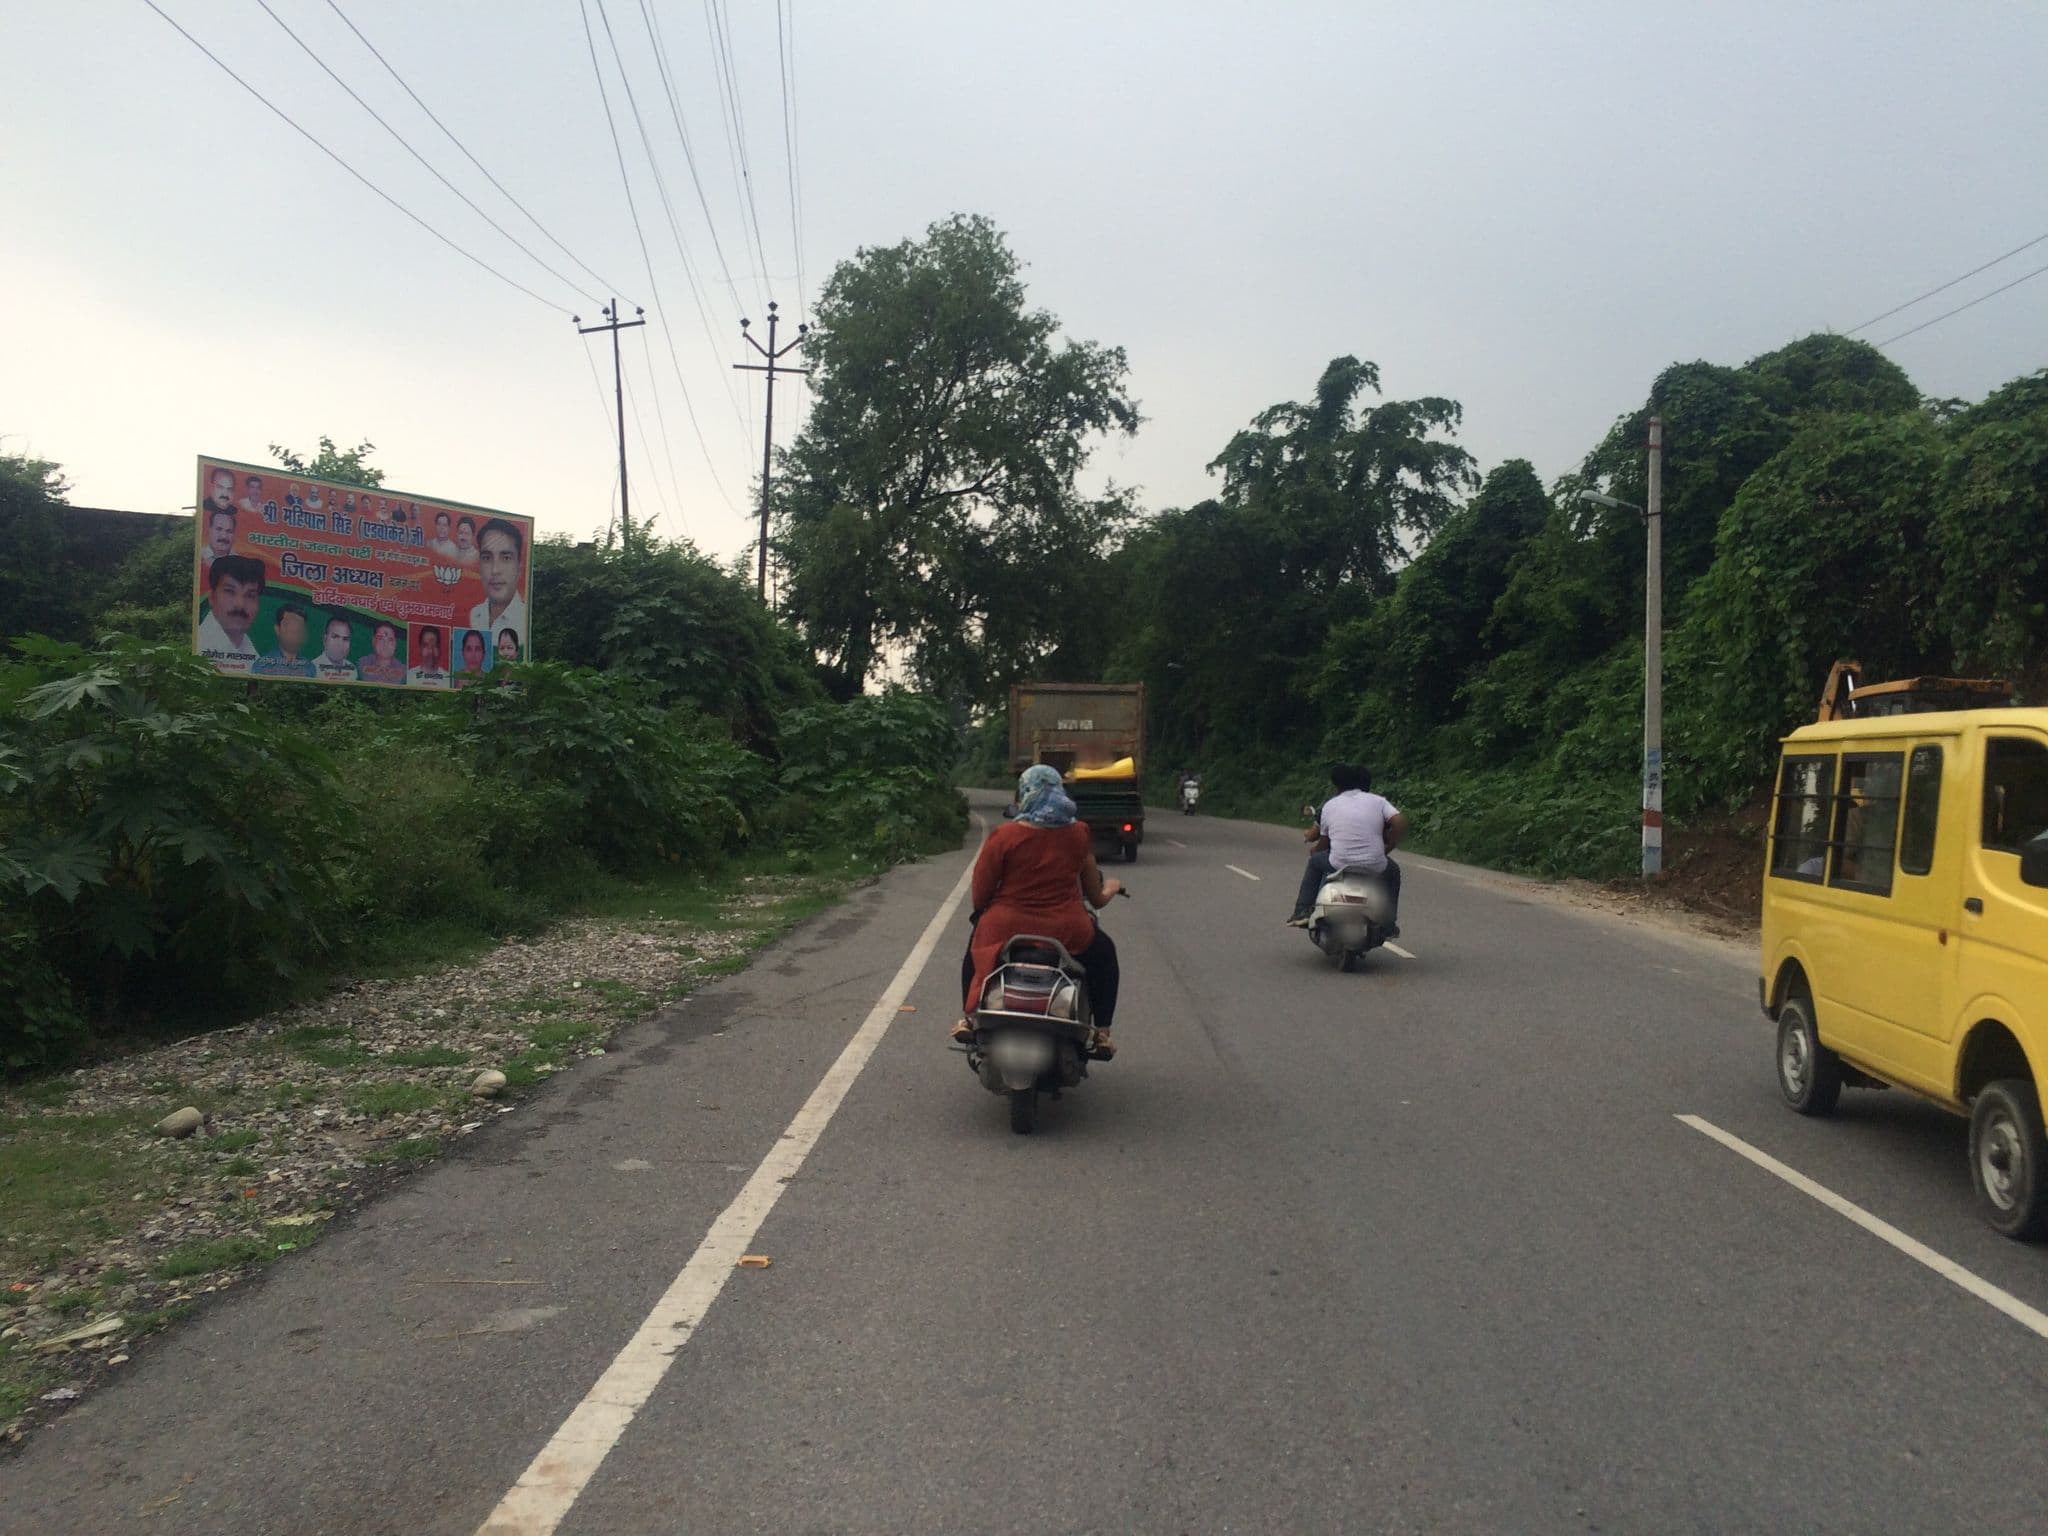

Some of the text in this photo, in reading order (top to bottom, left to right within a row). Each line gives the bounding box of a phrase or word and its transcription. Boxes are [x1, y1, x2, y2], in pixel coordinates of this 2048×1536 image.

[264, 501, 277, 523] श्री
[248, 532, 299, 549] भारतीय
[304, 540, 343, 555] जनता
[281, 552, 328, 581] जिला
[333, 566, 384, 589] अध्यक्ष
